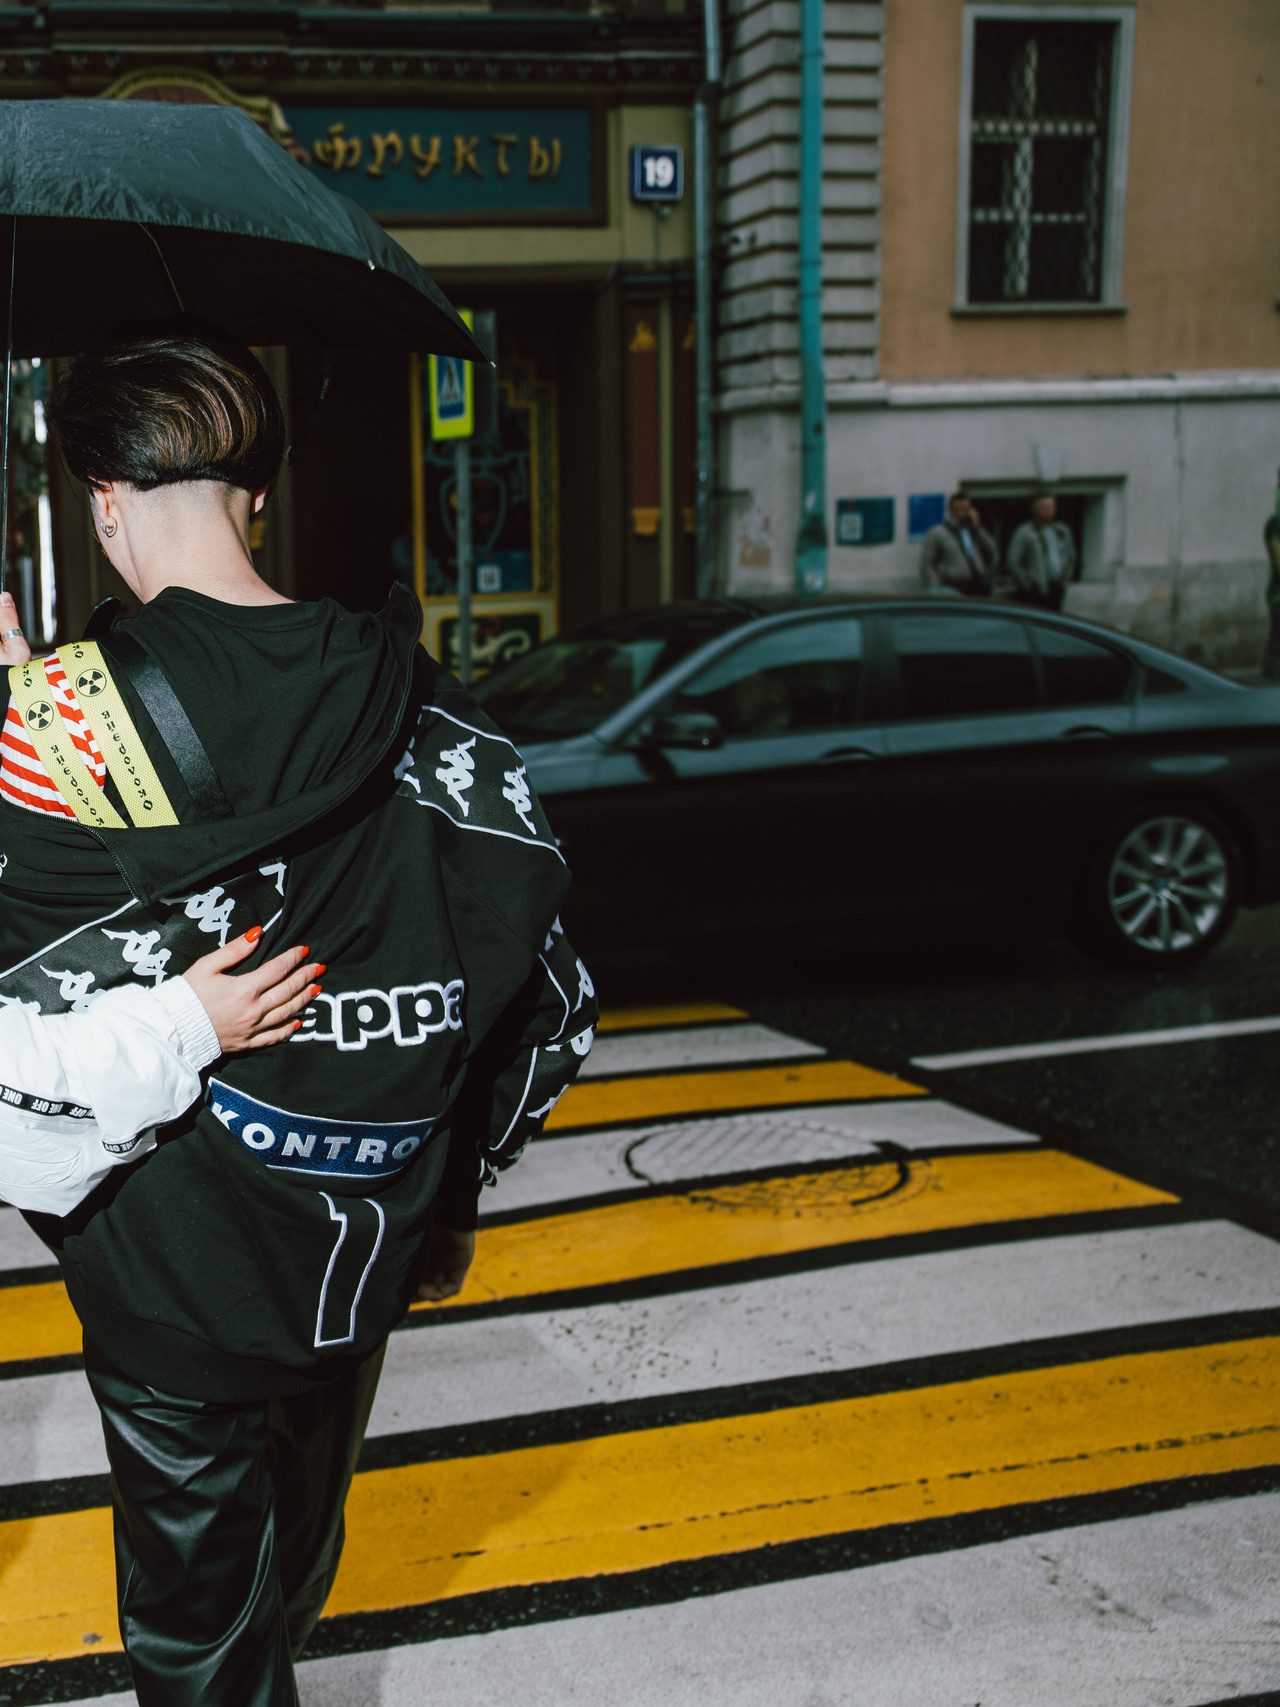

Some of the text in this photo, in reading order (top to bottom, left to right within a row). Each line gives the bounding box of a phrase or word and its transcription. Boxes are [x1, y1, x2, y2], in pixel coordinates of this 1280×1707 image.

[642, 155, 675, 188] 19
[290, 979, 464, 1051] appa
[2, 1088, 23, 1105] ONE
[31, 1099, 50, 1113] OFF
[211, 1102, 431, 1164] KONTRO
